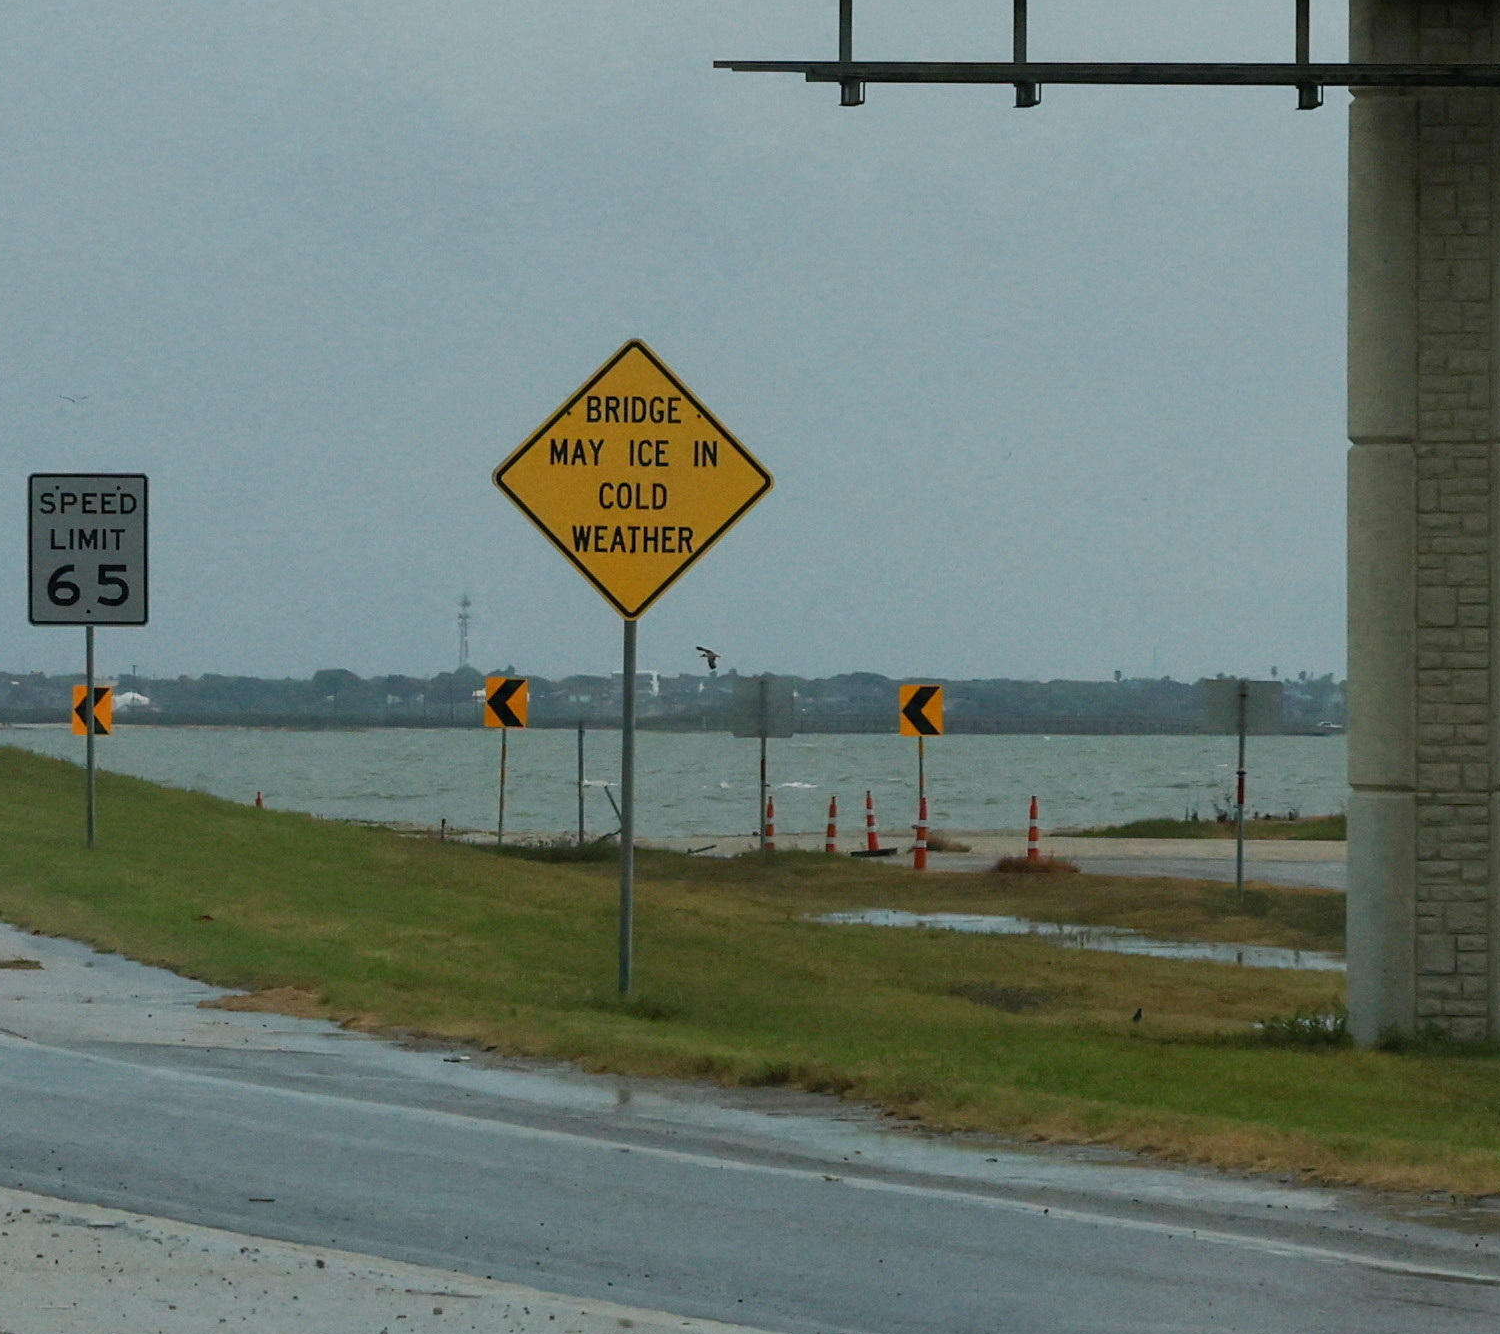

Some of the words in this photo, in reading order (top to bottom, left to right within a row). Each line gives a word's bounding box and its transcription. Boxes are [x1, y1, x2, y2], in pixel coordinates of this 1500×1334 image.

[586, 395, 682, 424] BRIDGE
[550, 438, 605, 466] MAY
[629, 439, 669, 467] ICE
[693, 440, 719, 468] IN
[39, 492, 138, 516] SPEED
[599, 482, 668, 510] COLD
[50, 528, 127, 551] LIMIT
[572, 525, 694, 554] WEATHER
[46, 563, 131, 607] 65
